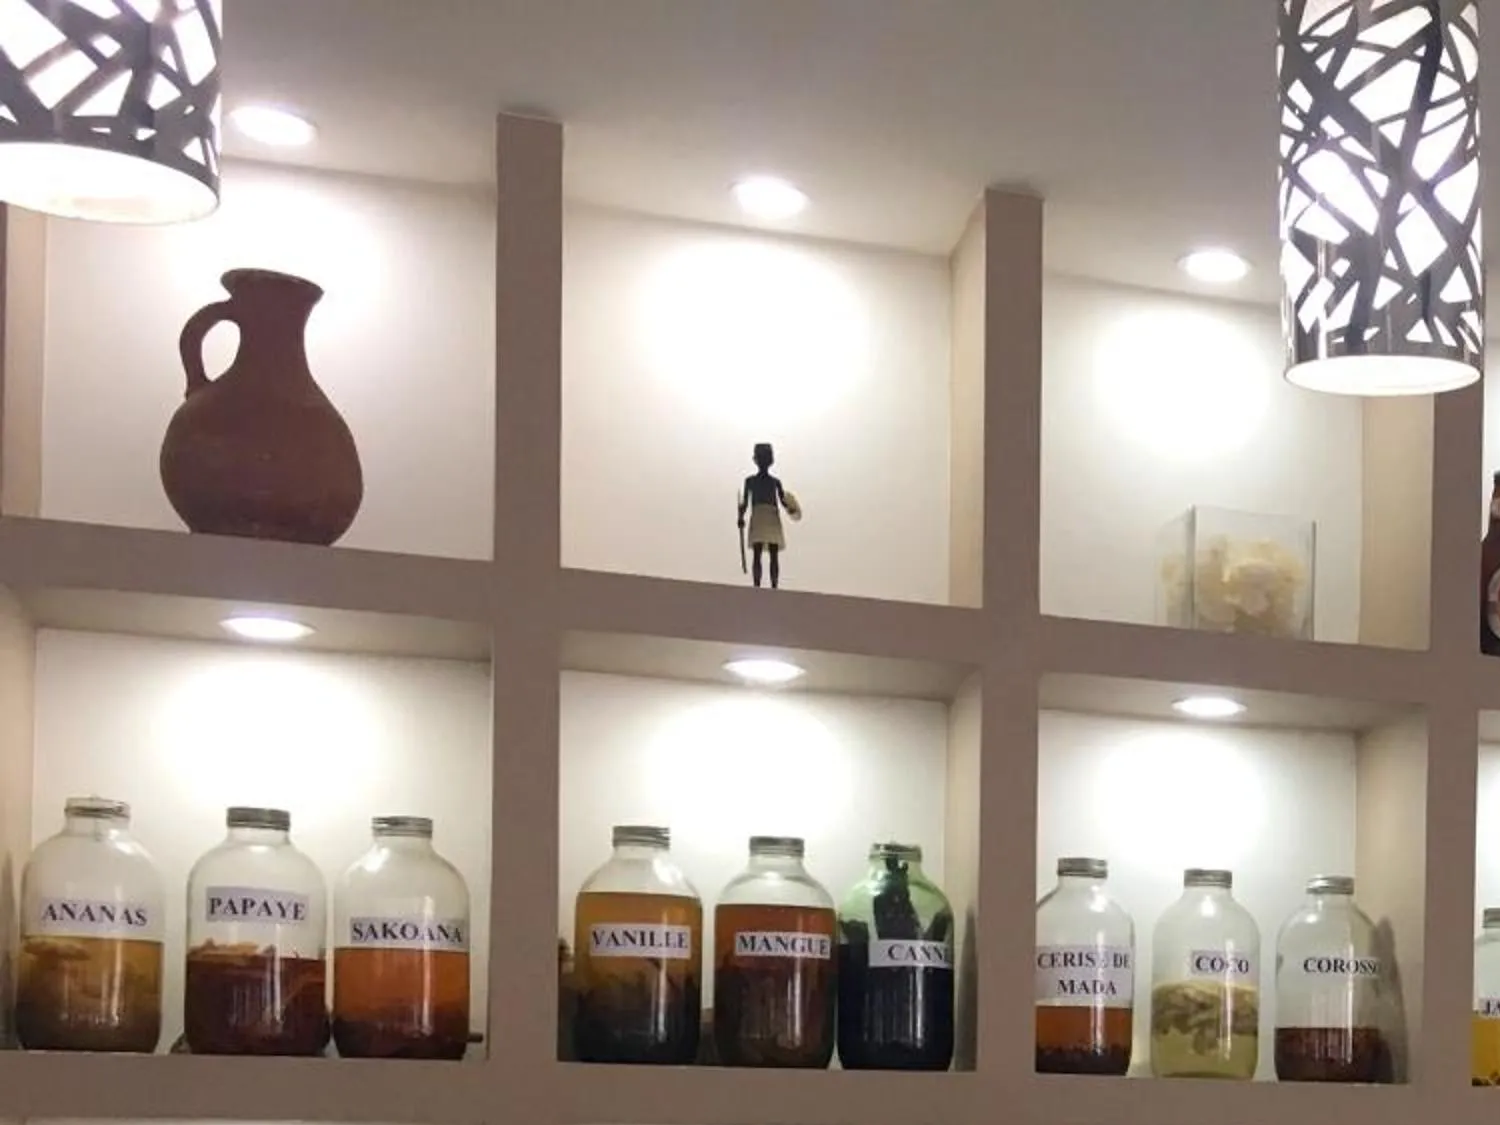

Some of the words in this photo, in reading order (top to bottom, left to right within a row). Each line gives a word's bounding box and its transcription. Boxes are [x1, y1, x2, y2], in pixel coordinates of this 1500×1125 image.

[41, 902, 149, 927] ANANAS
[208, 896, 307, 921] PAPAYE
[352, 921, 463, 945] SAKOANA
[591, 928, 689, 950] VANILLE
[738, 935, 830, 955] MANGUE
[887, 944, 949, 961] CANN
[1195, 955, 1249, 974] COCO
[1056, 979, 1116, 995] MADA
